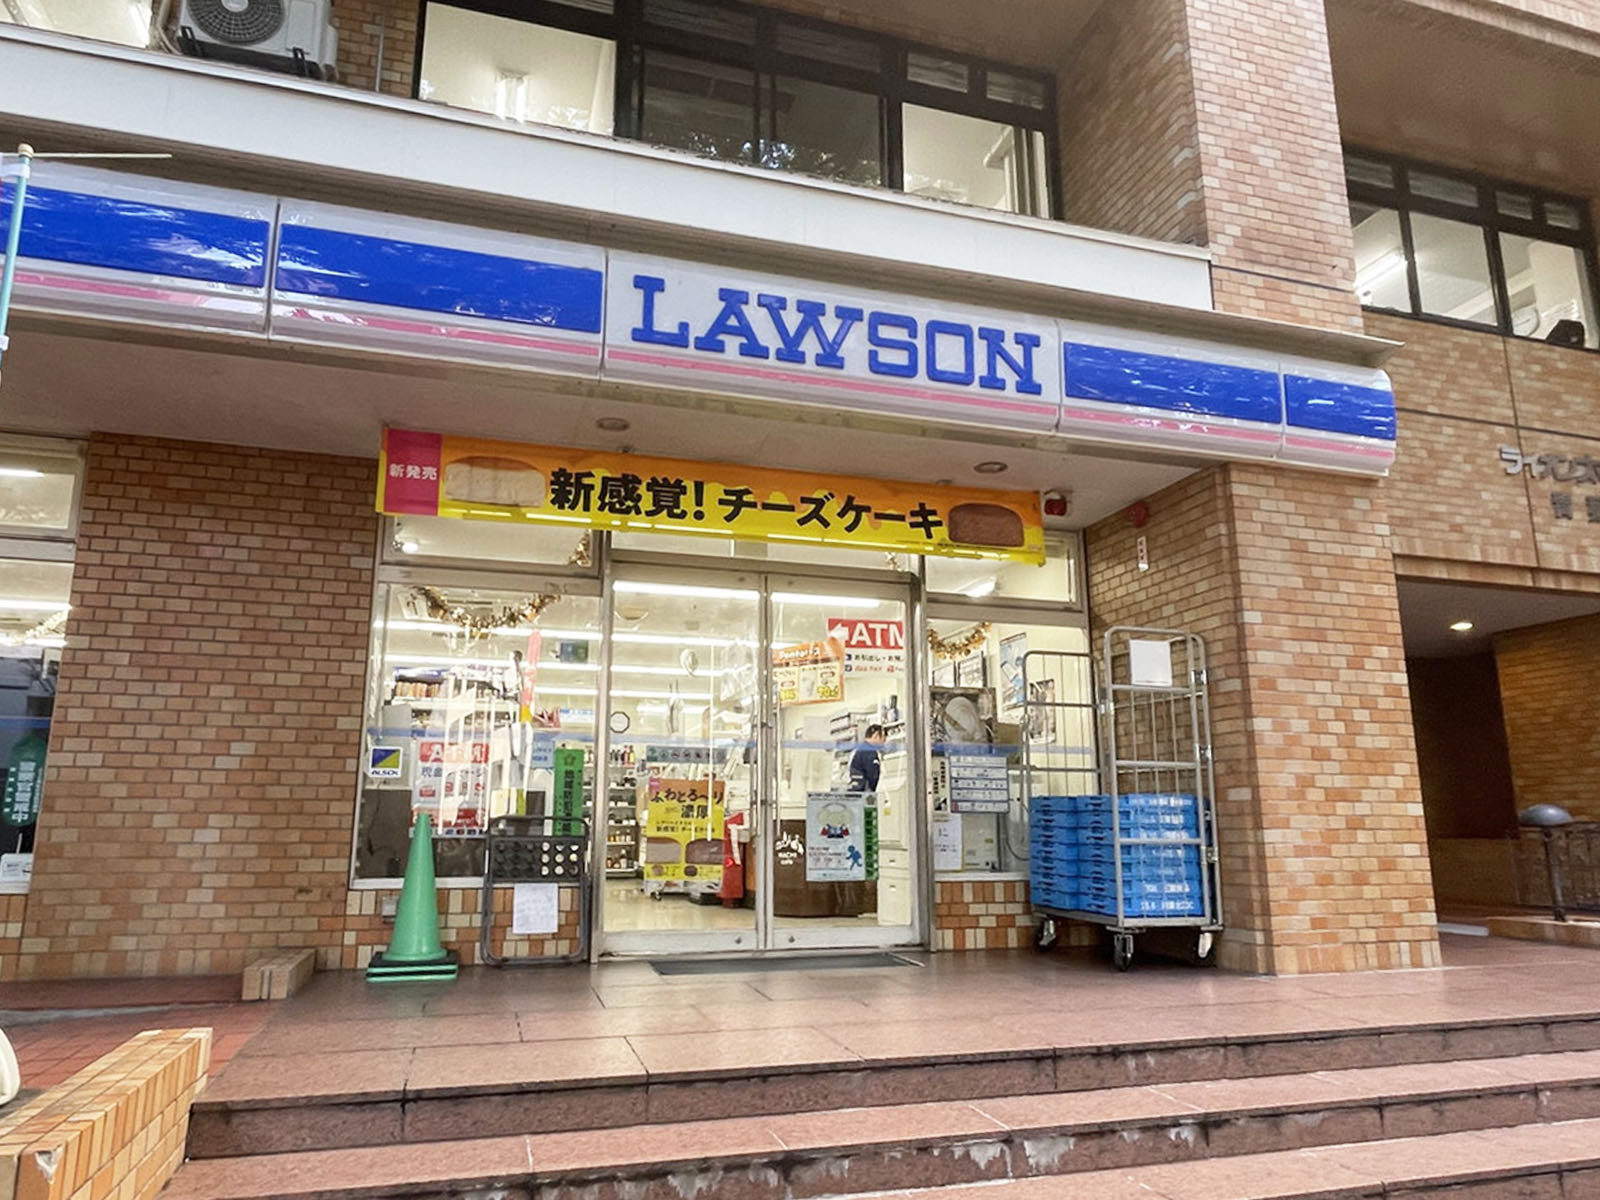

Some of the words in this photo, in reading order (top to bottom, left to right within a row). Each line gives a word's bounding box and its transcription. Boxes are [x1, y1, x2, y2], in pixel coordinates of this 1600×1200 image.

[631, 275, 1042, 395] LAWSON
[389, 463, 437, 480] 新発売
[850, 622, 904, 648] ATM
